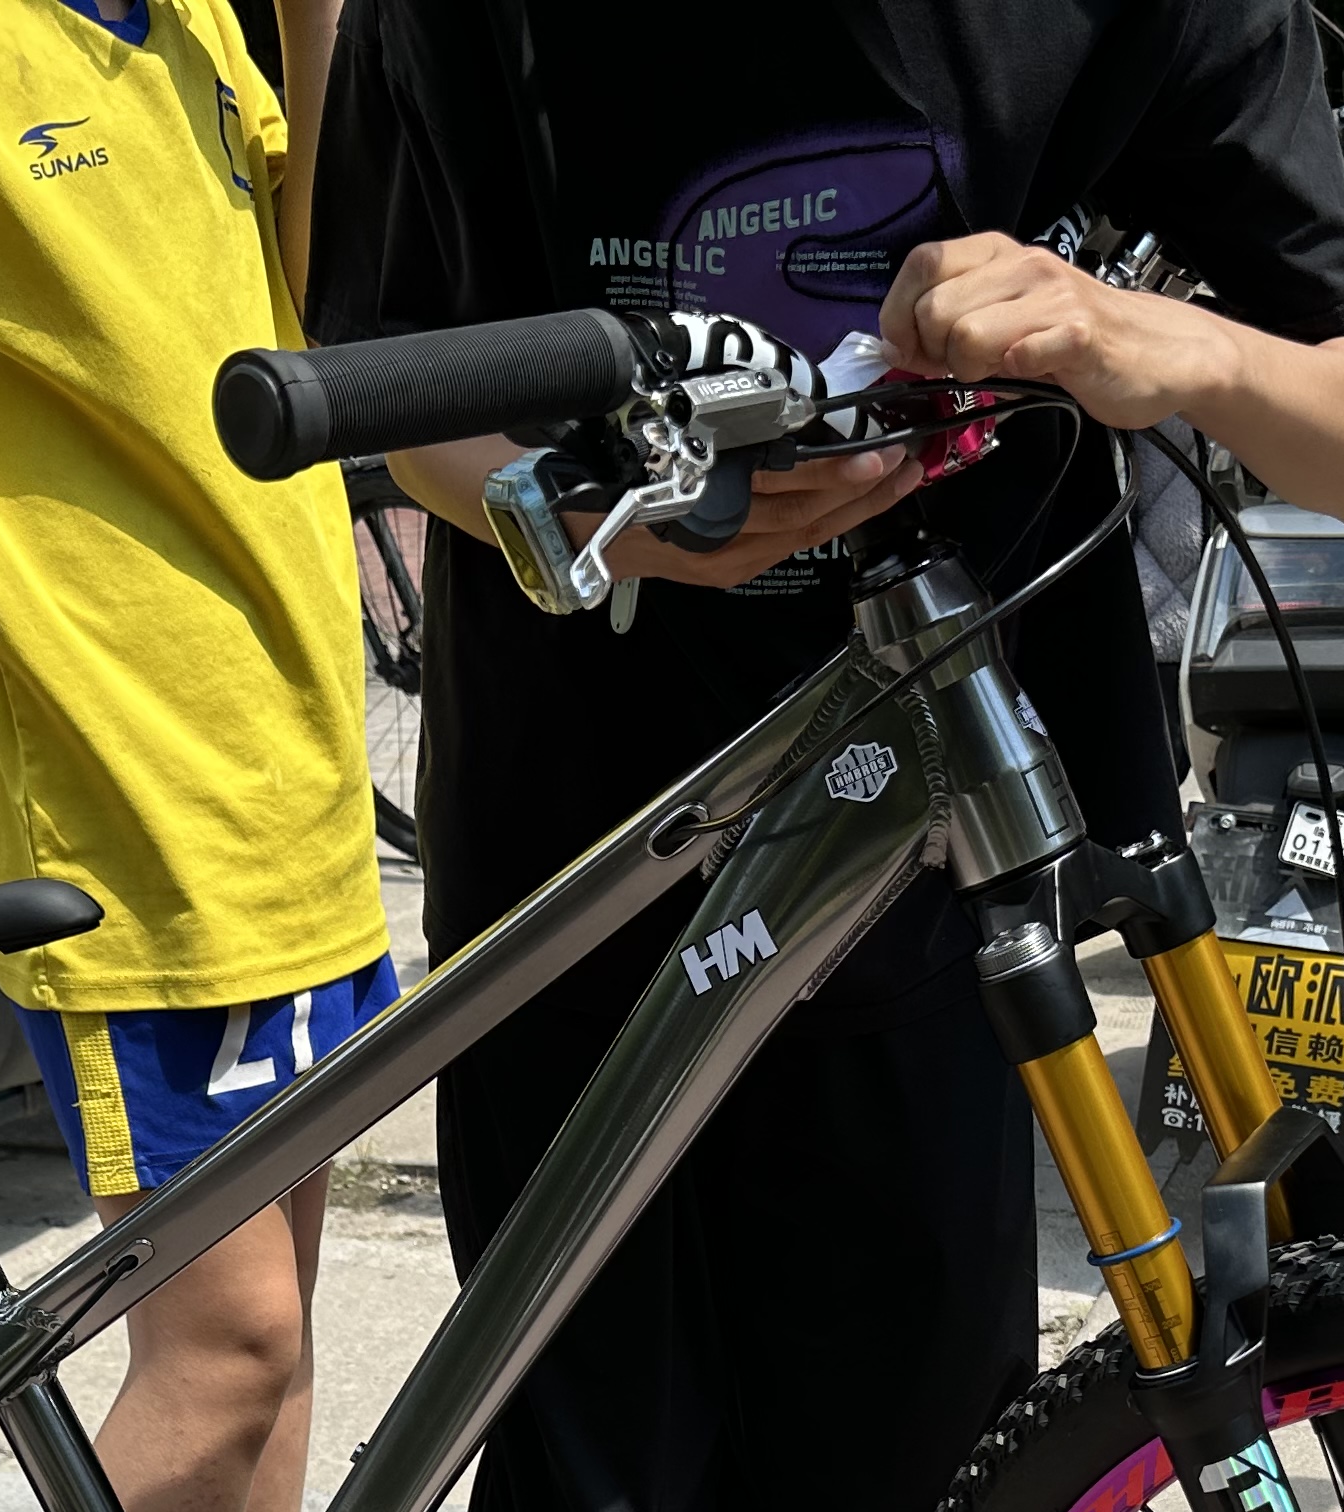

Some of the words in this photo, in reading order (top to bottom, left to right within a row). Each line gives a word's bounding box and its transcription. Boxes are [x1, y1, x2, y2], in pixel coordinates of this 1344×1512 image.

[29, 146, 109, 181] SUNAIS
[697, 188, 837, 242] ANGELIC
[589, 237, 726, 275] ANGELIC
[834, 755, 887, 789] HMBROS
[680, 908, 779, 996] HM
